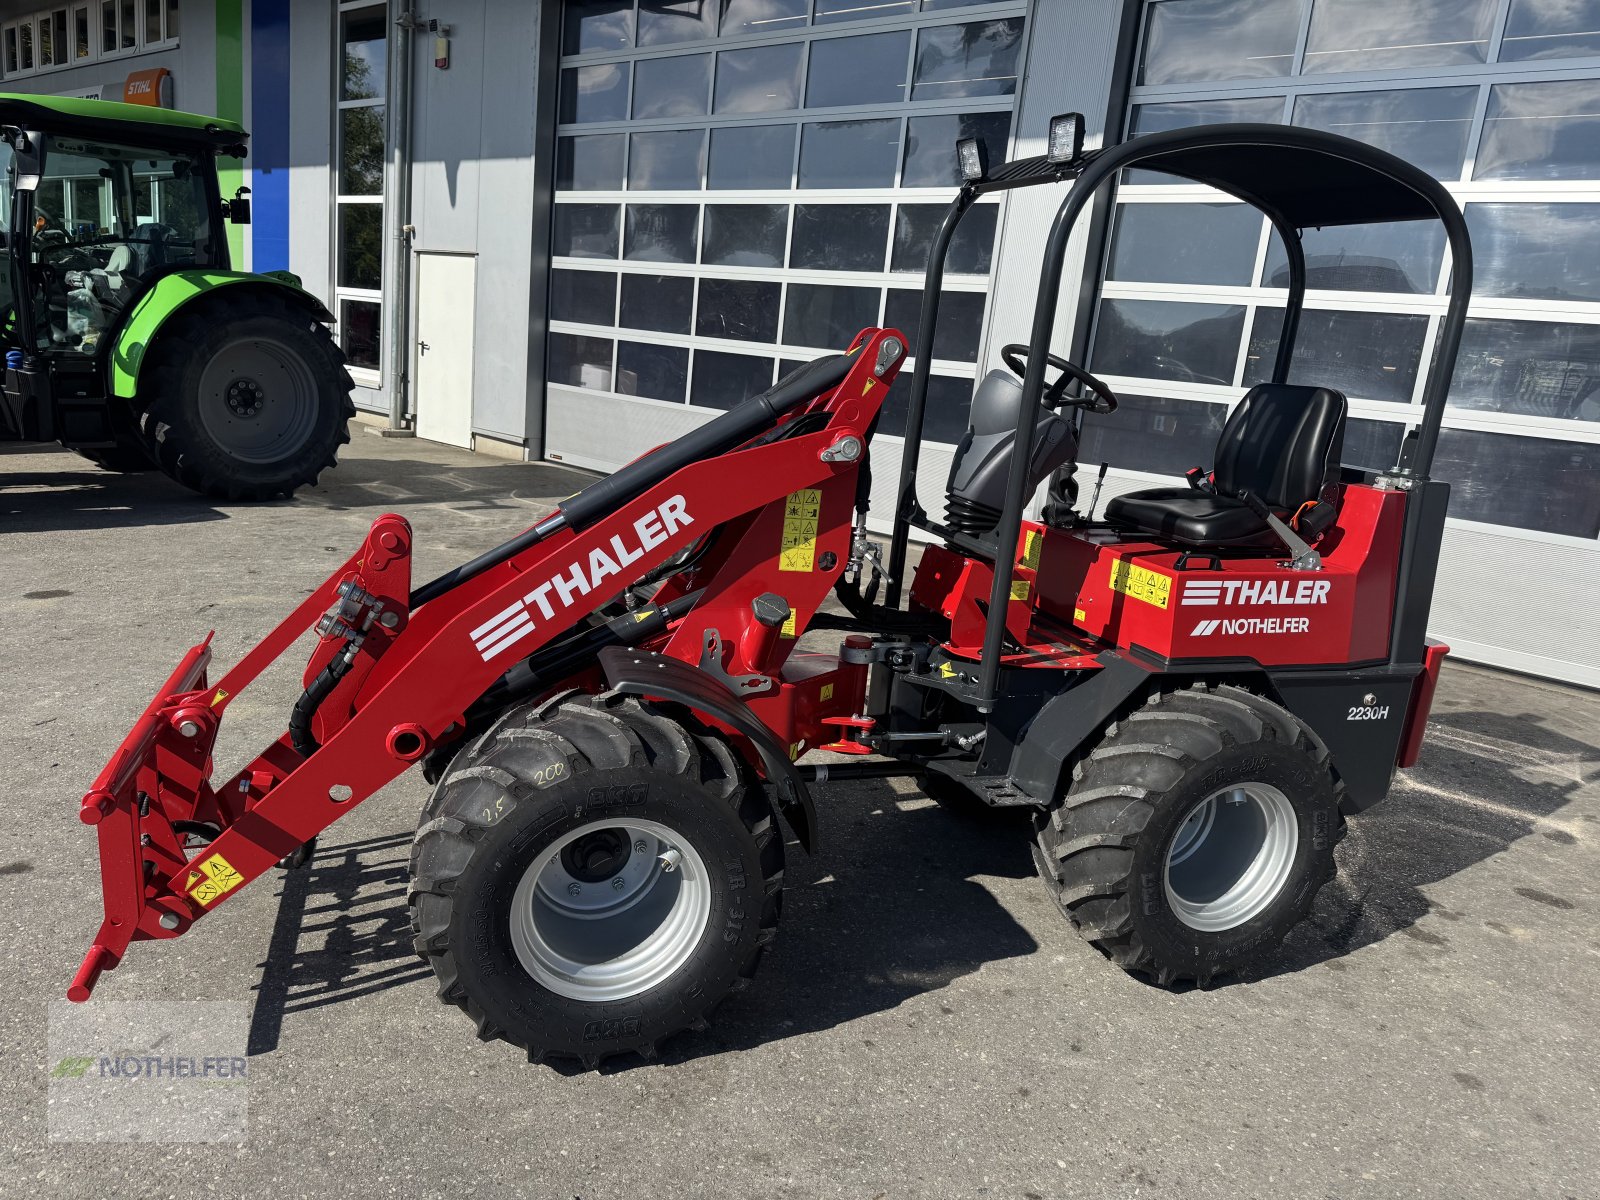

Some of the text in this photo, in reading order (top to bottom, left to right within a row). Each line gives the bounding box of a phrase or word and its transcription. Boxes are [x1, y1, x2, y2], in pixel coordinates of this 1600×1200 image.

[127, 80, 151, 95] STIHL
[523, 494, 694, 621] THALER
[1223, 580, 1331, 605] THALER
[1221, 617, 1310, 635] NOTHELFER
[1346, 705, 1390, 721] 2230H
[534, 762, 564, 786] 200
[585, 783, 649, 809] BKT
[581, 1015, 643, 1043] BKT
